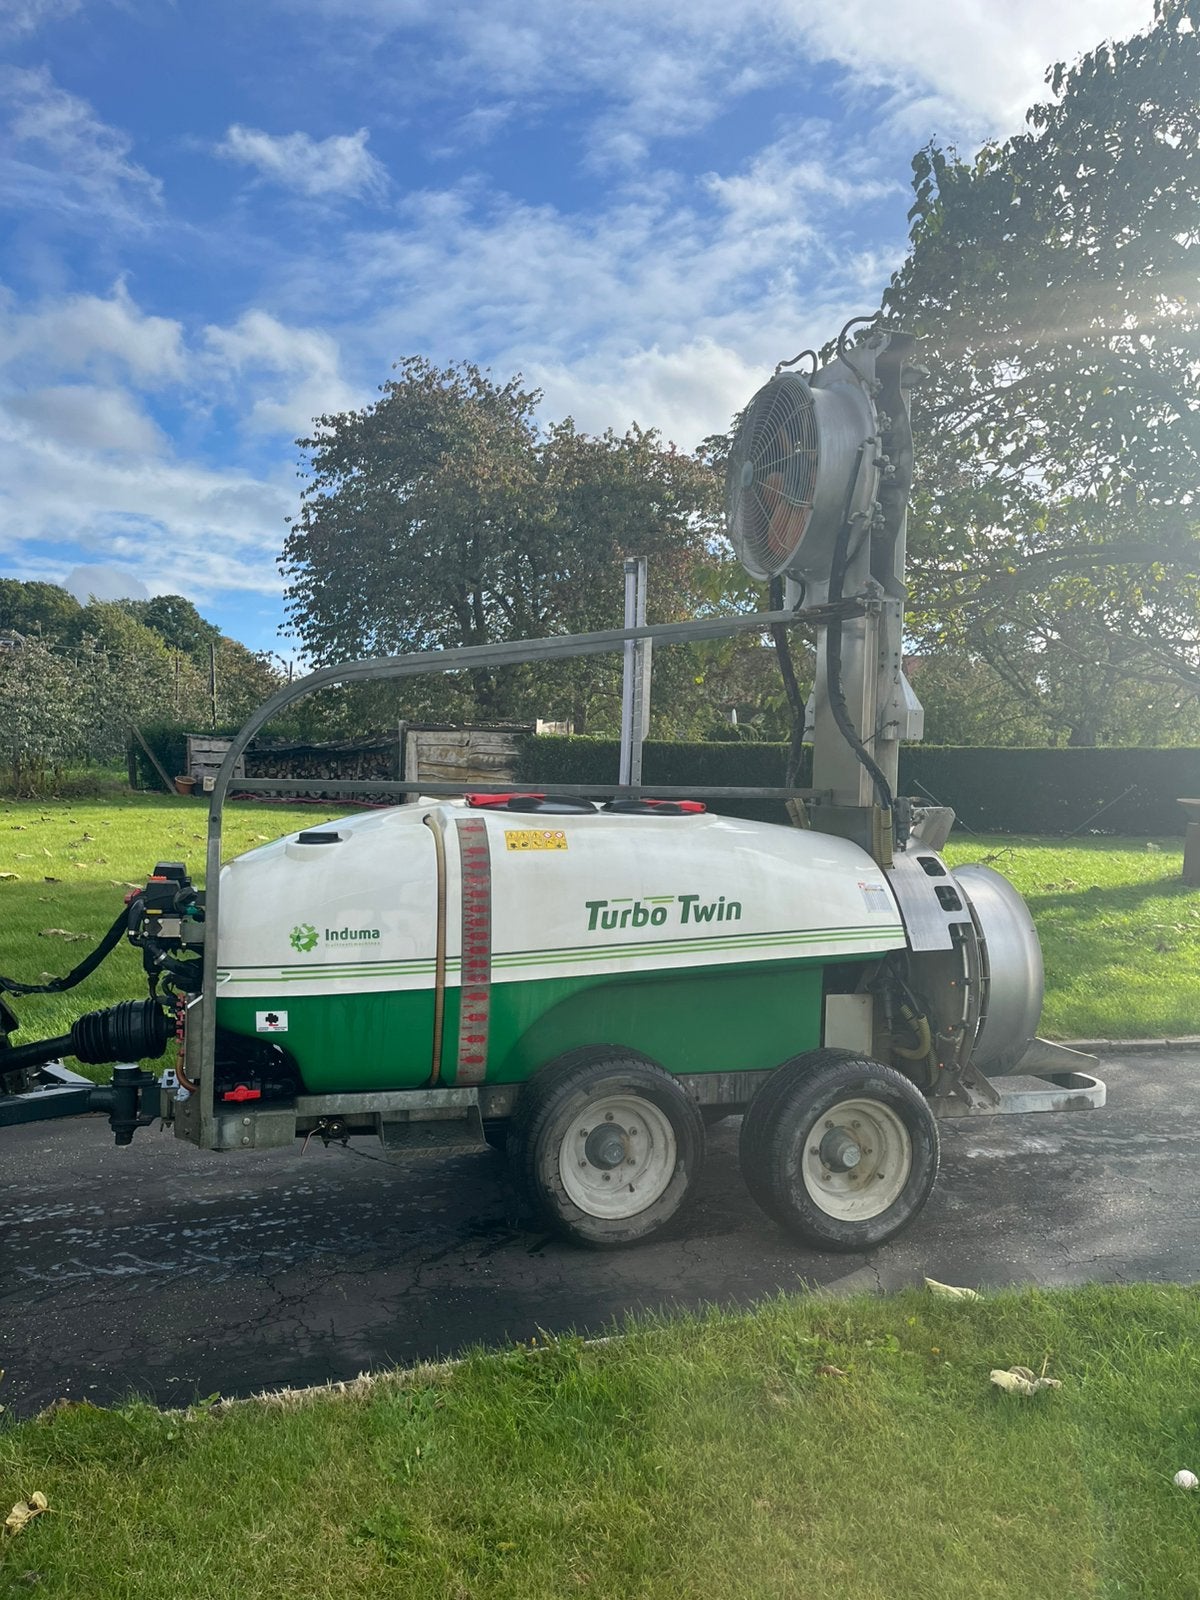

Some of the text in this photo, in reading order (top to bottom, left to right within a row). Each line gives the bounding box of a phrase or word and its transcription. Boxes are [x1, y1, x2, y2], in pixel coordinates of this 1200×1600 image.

[585, 894, 742, 931] Turbo Twin
[325, 927, 380, 941] Induma
